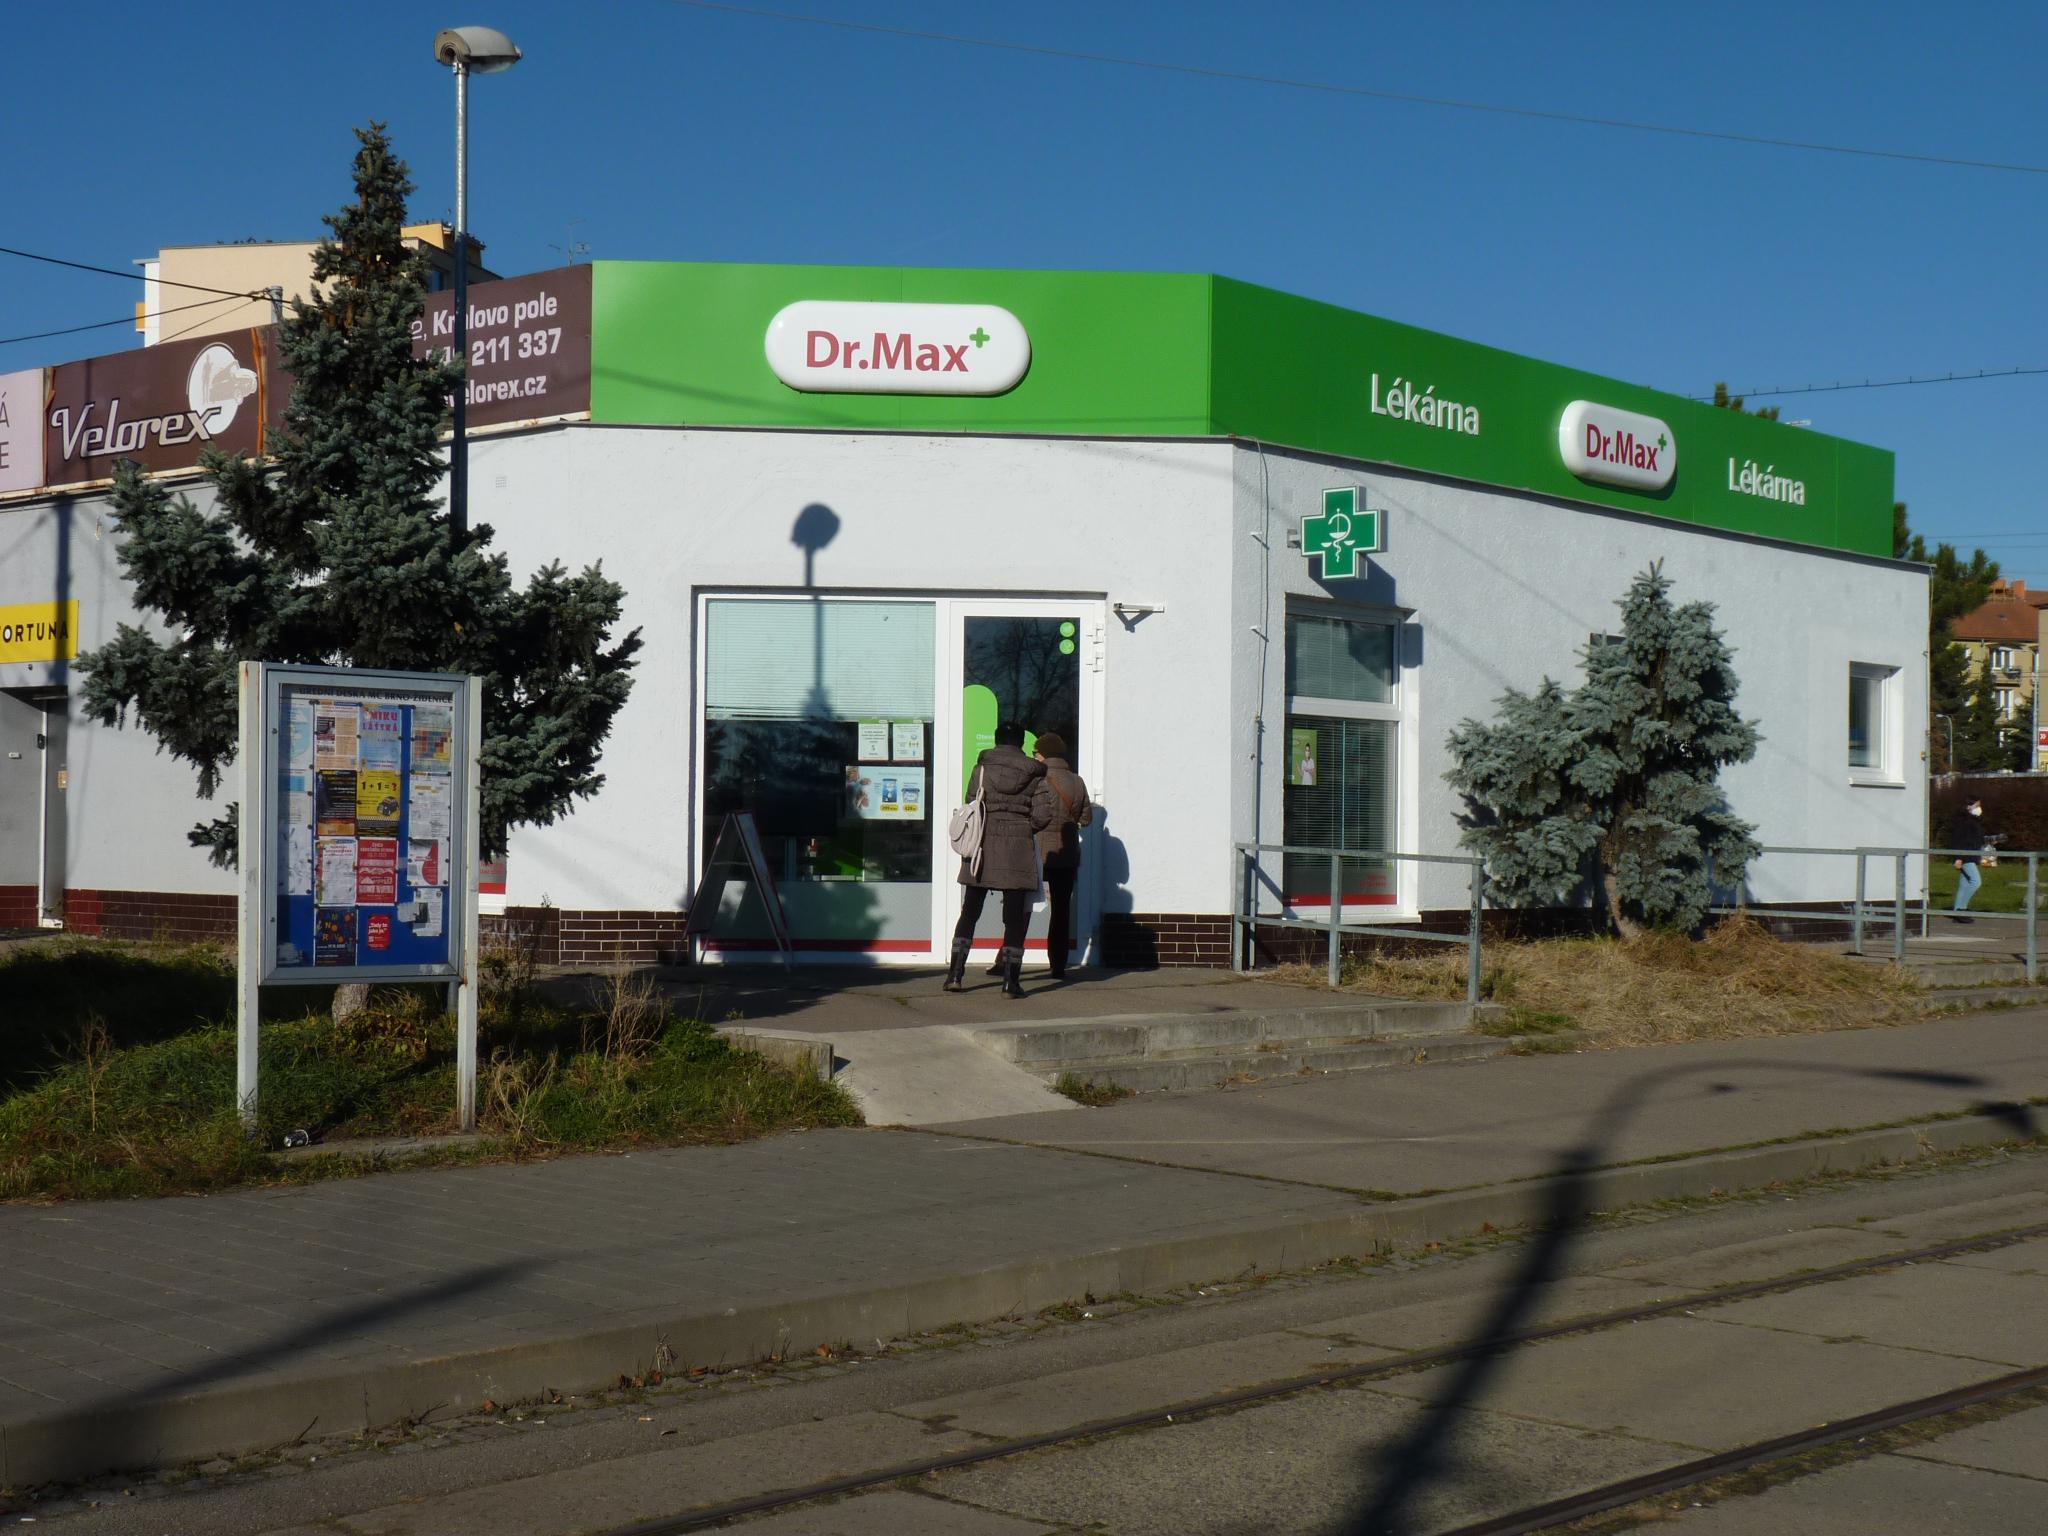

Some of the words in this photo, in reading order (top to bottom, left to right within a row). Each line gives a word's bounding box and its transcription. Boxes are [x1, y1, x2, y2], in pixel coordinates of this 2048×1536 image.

[433, 304, 509, 336] Krlovo
[514, 291, 558, 329] pole
[471, 336, 510, 366] 211
[518, 327, 562, 359] 337
[1371, 373, 1480, 436] Lékárna
[51, 398, 222, 461] Velorex
[1728, 457, 1805, 506] Lékárna
[0, 620, 69, 644] ORTUNA
